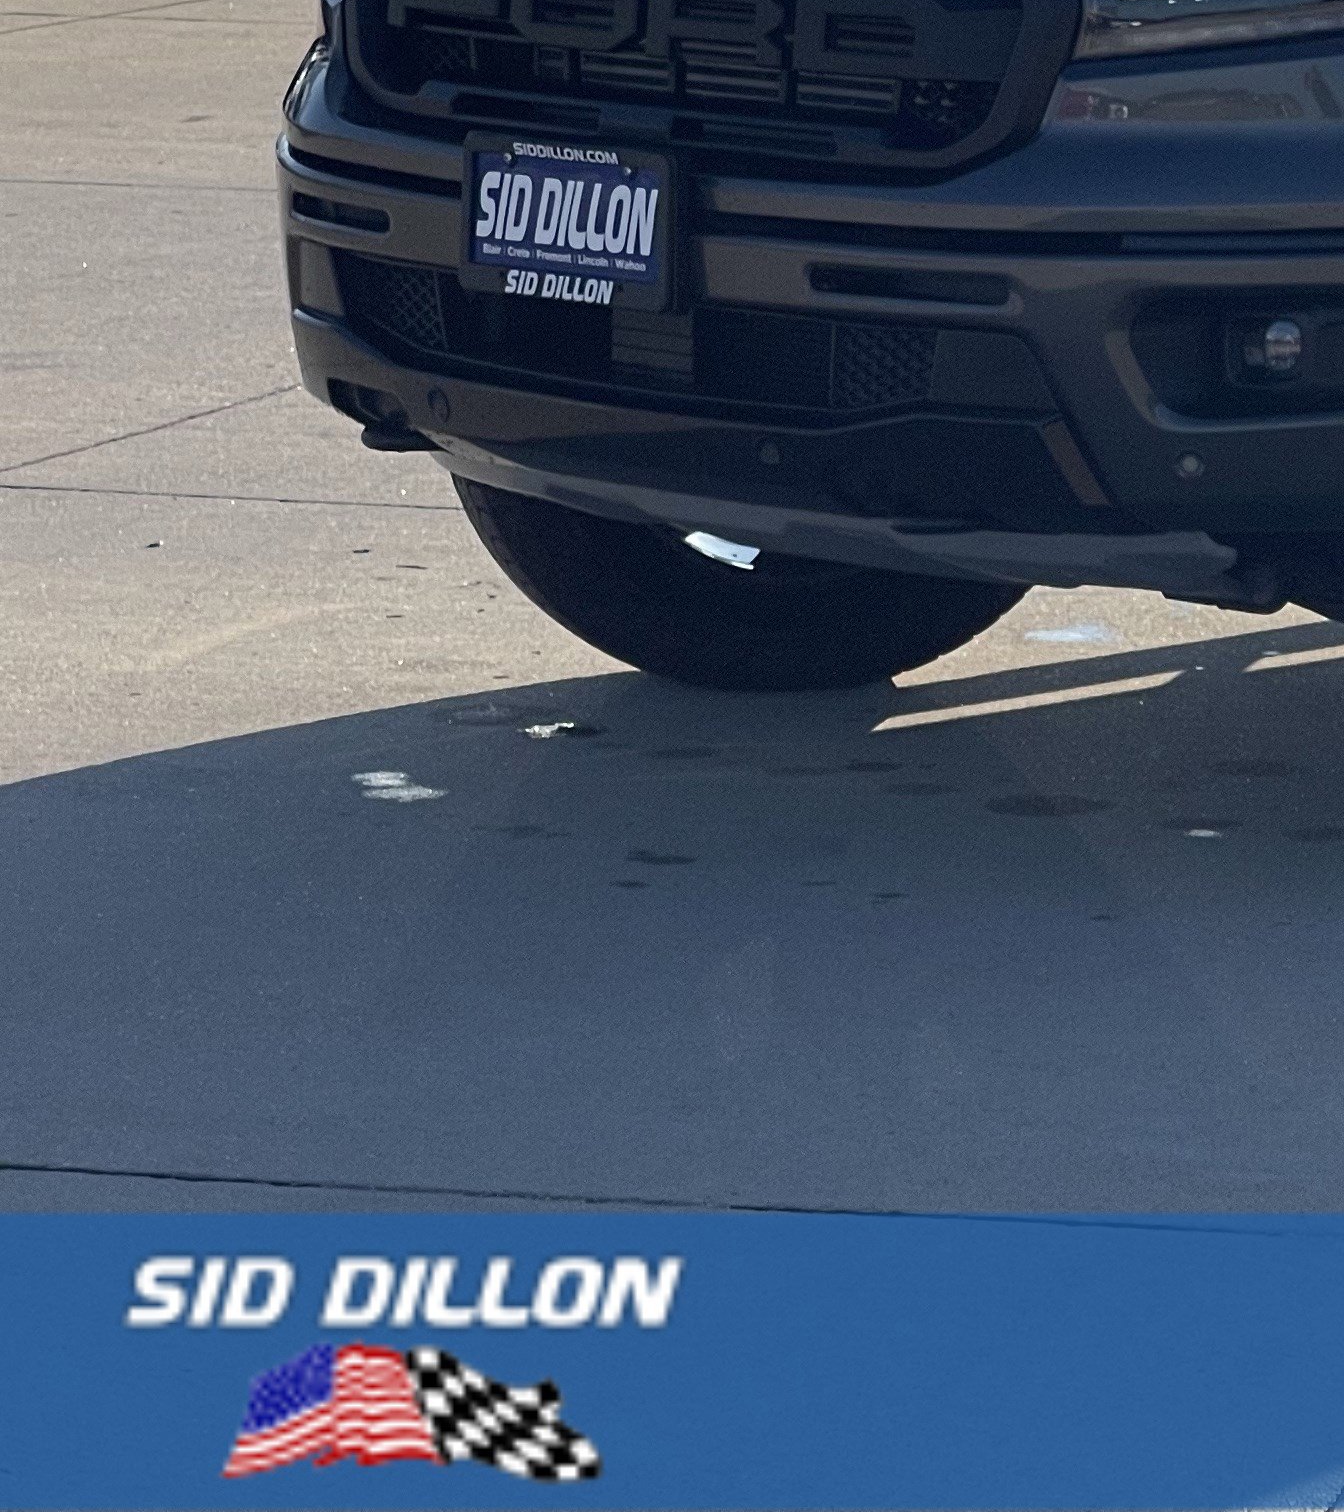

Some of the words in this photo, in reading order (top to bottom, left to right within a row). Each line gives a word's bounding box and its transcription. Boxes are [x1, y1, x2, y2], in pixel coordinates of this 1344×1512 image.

[512, 141, 619, 165] SIDDILLON.COM
[475, 170, 533, 242] SID
[534, 177, 659, 257] DILLON
[504, 269, 539, 296] SID
[541, 273, 614, 305] DILLON
